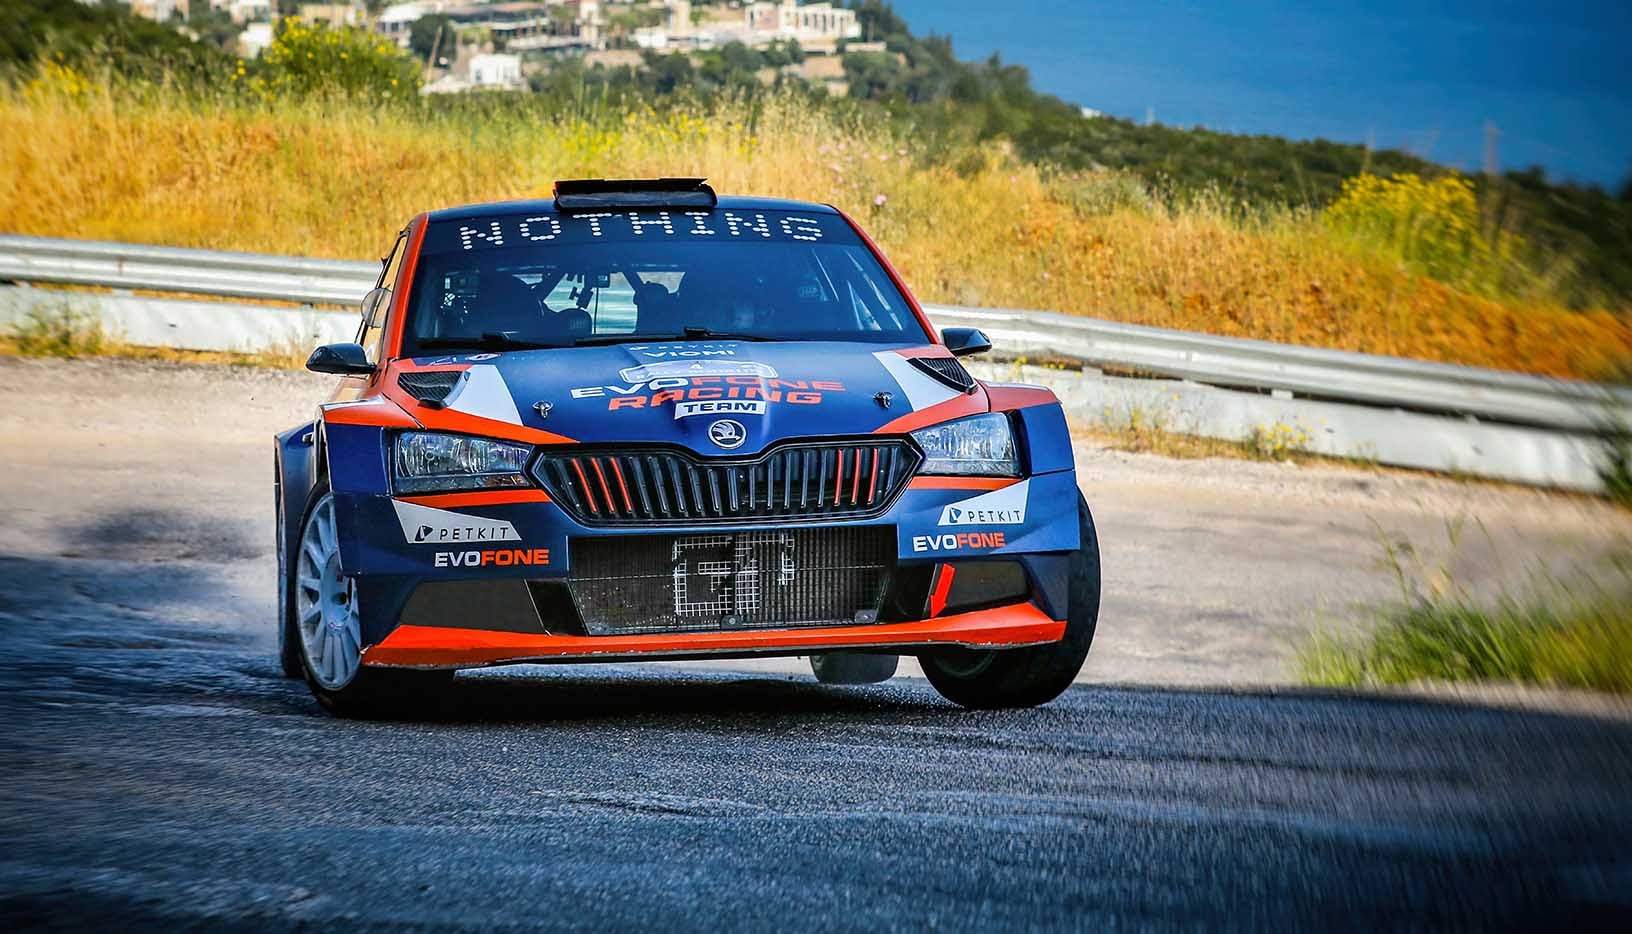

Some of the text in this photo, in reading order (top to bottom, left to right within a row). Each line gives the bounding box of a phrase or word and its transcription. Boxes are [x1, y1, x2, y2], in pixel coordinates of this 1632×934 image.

[459, 211, 823, 250] NOTHING
[643, 350, 736, 358] VIOMI
[570, 376, 847, 399] EVOFONE
[608, 387, 822, 410] RACING
[683, 402, 757, 413] TEAM
[966, 510, 1021, 522] PETKIT
[439, 527, 509, 540] PETKIT
[912, 532, 1006, 552] EVOFONE
[434, 549, 550, 567] EVOFONE
